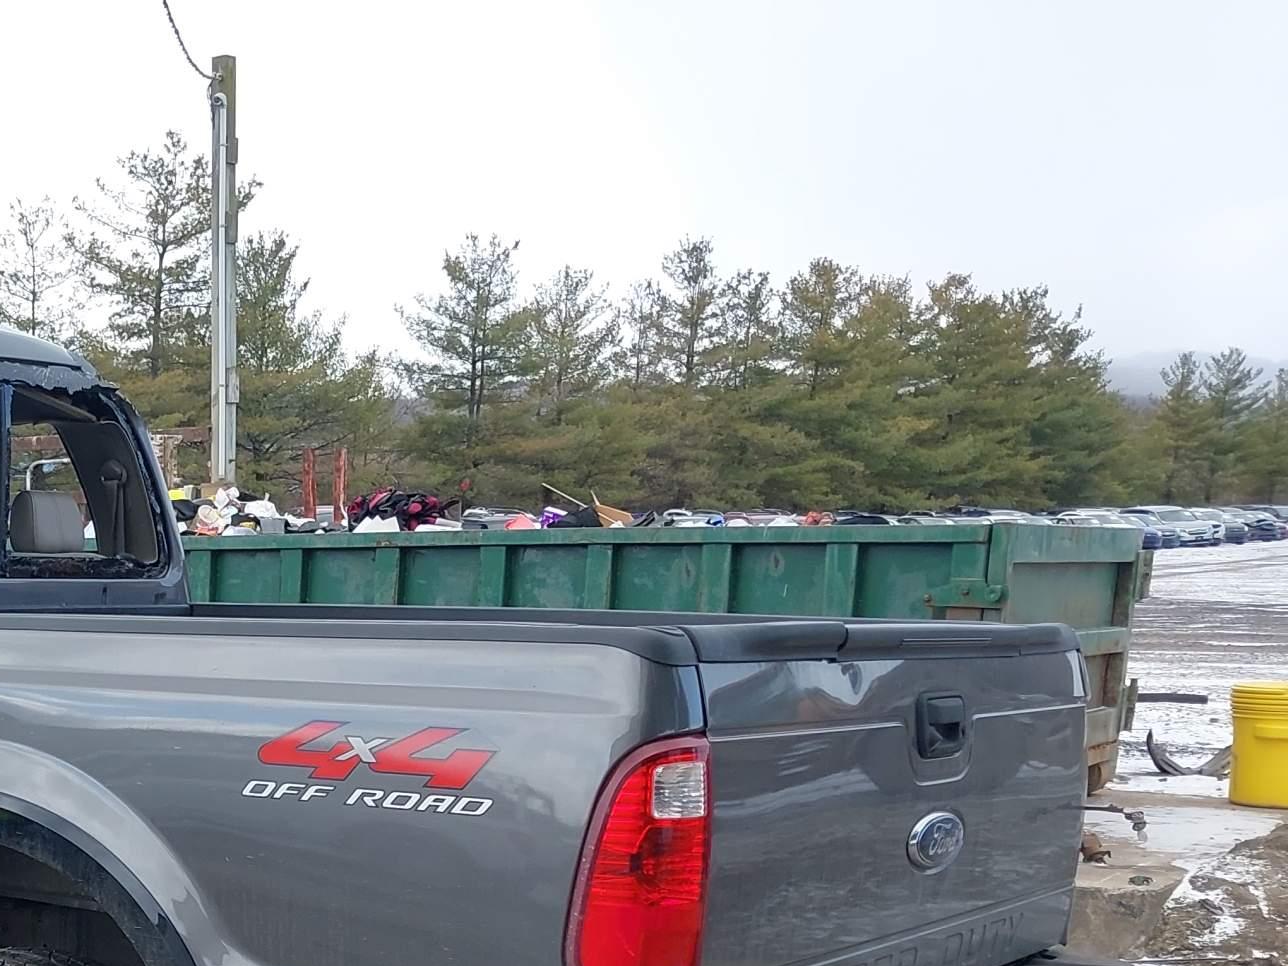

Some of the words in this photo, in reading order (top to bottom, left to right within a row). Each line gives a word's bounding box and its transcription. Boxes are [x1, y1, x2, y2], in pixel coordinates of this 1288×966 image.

[241, 779, 336, 801] OFF
[344, 787, 495, 817] ROAD
[928, 822, 961, 856] Ford
